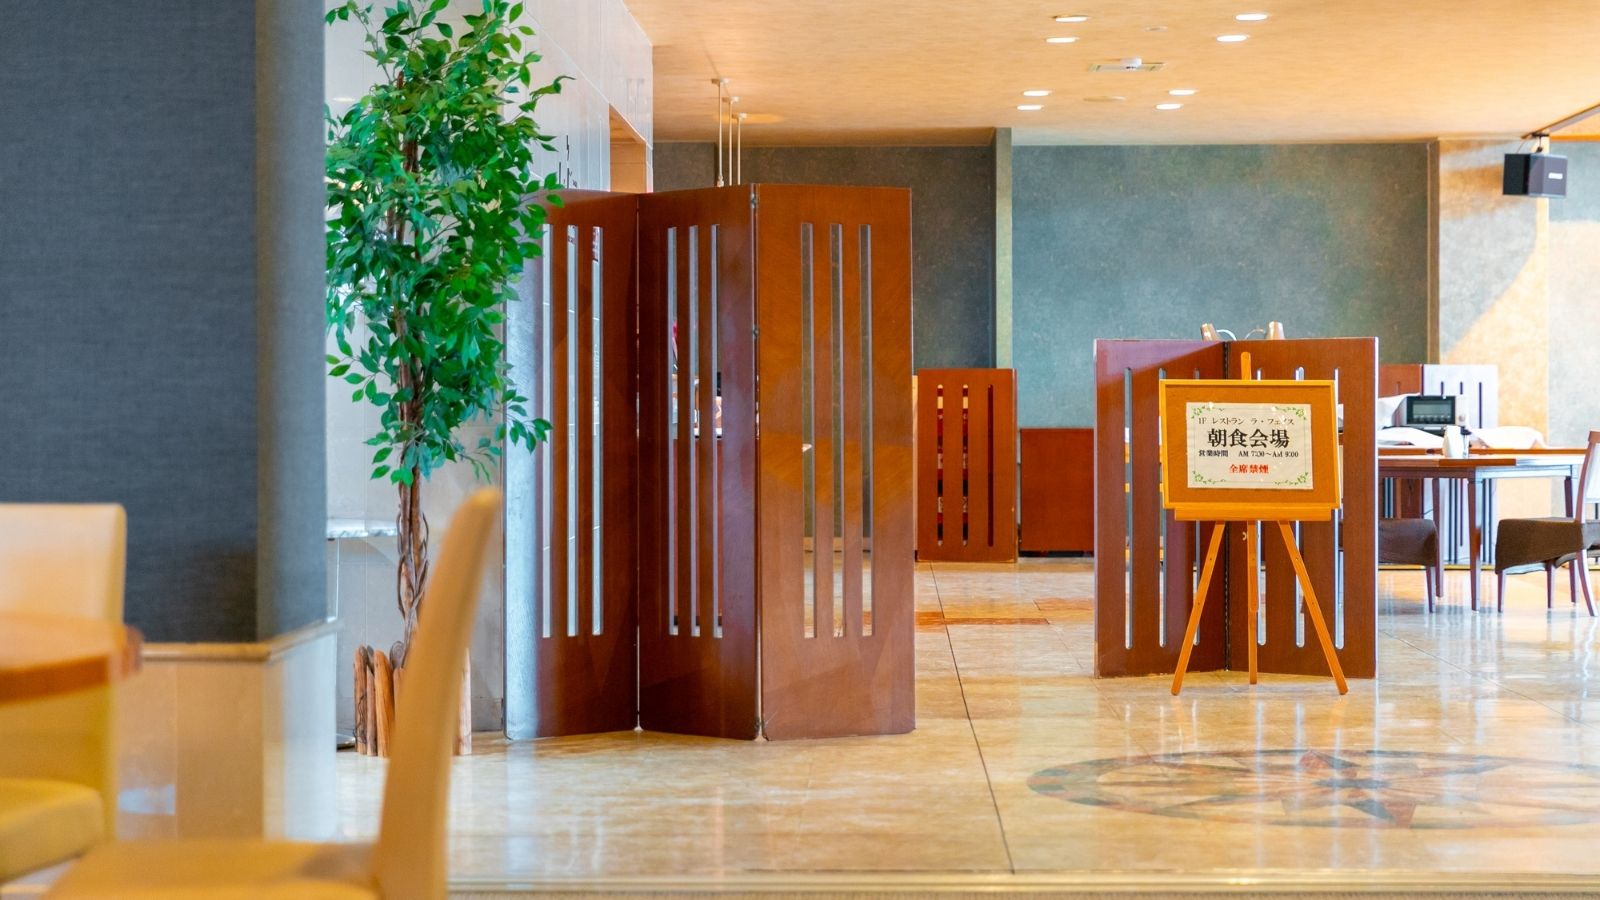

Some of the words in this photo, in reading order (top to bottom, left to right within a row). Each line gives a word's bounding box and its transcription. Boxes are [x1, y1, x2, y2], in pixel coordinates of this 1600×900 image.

[1212, 417, 1245, 425] レストラン
[1207, 428, 1290, 448] 朝食会場
[1198, 449, 1229, 458] 営業時間
[1229, 463, 1269, 474] 全席禁煙
